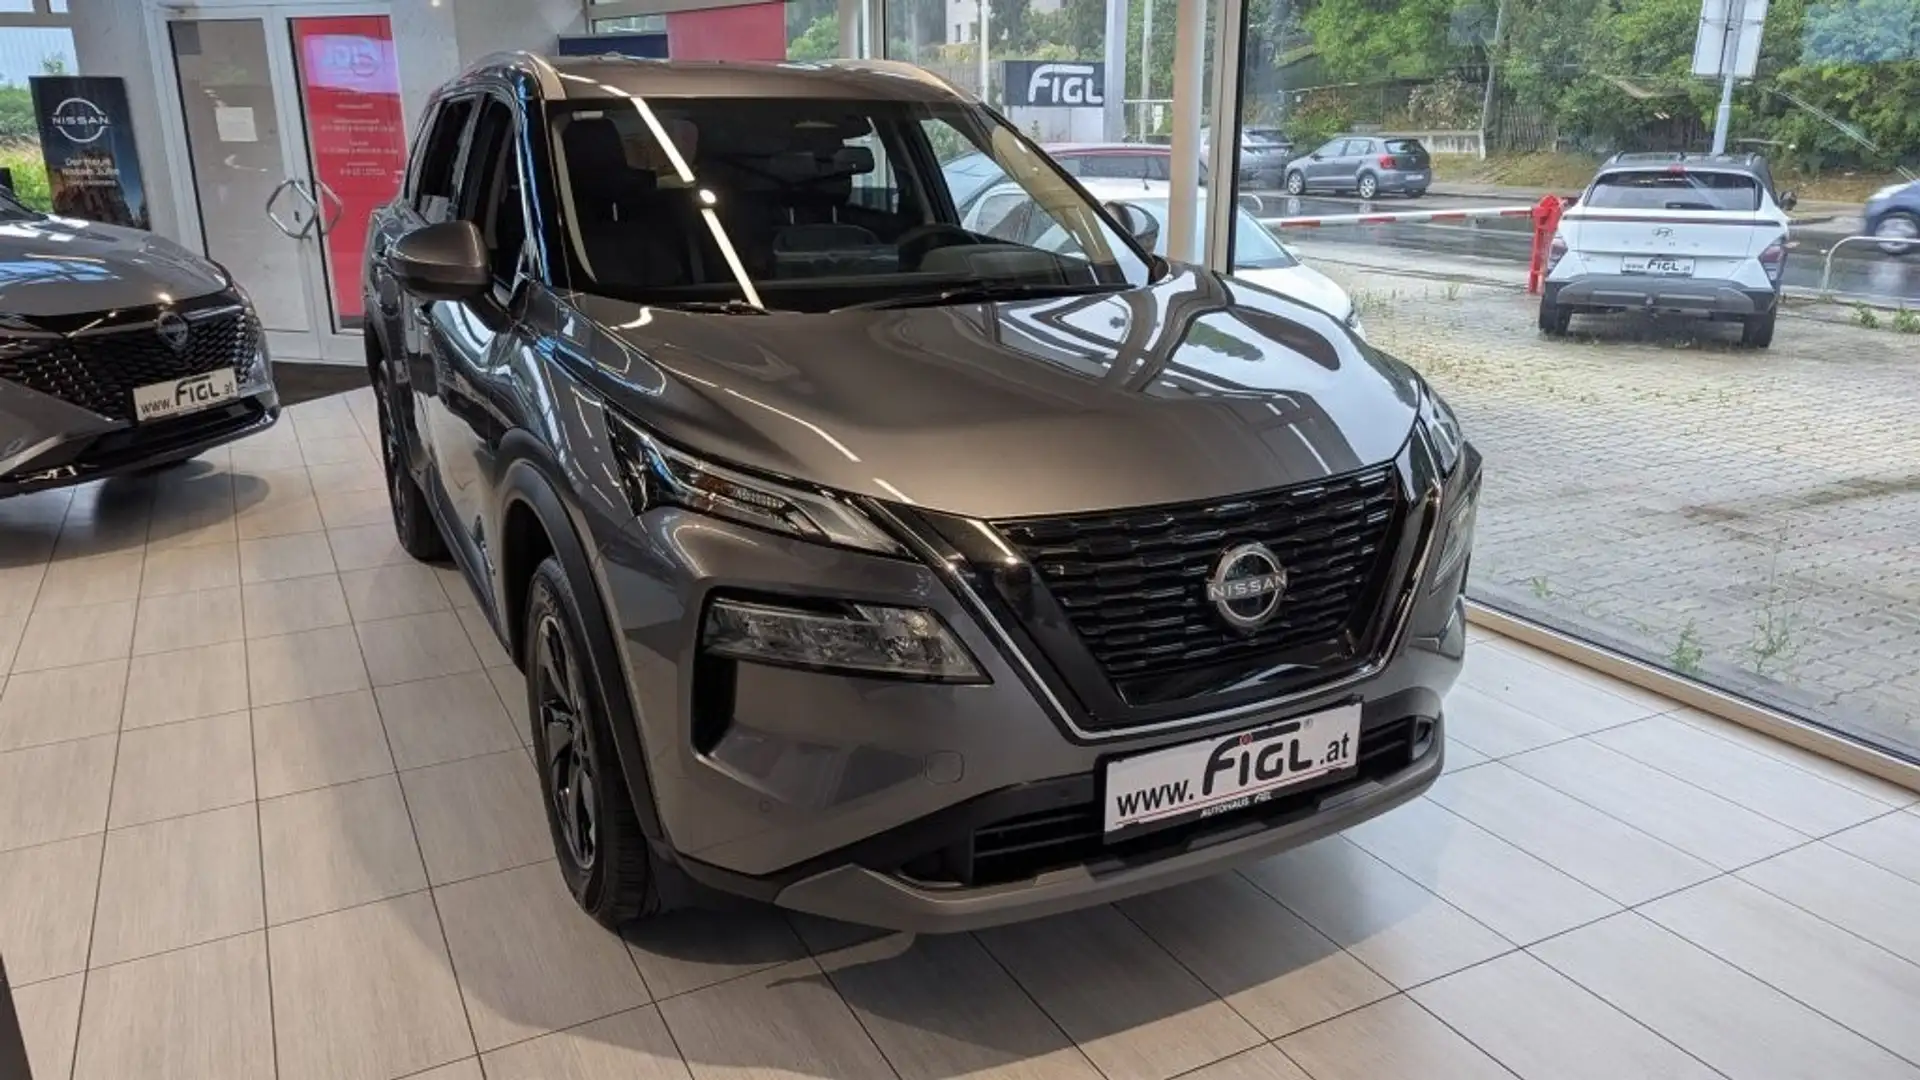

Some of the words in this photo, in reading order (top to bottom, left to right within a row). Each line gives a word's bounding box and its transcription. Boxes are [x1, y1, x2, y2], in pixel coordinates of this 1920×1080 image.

[1028, 64, 1104, 103] FIGL
[52, 116, 109, 125] NISSAN
[1210, 569, 1288, 599] NISSAN
